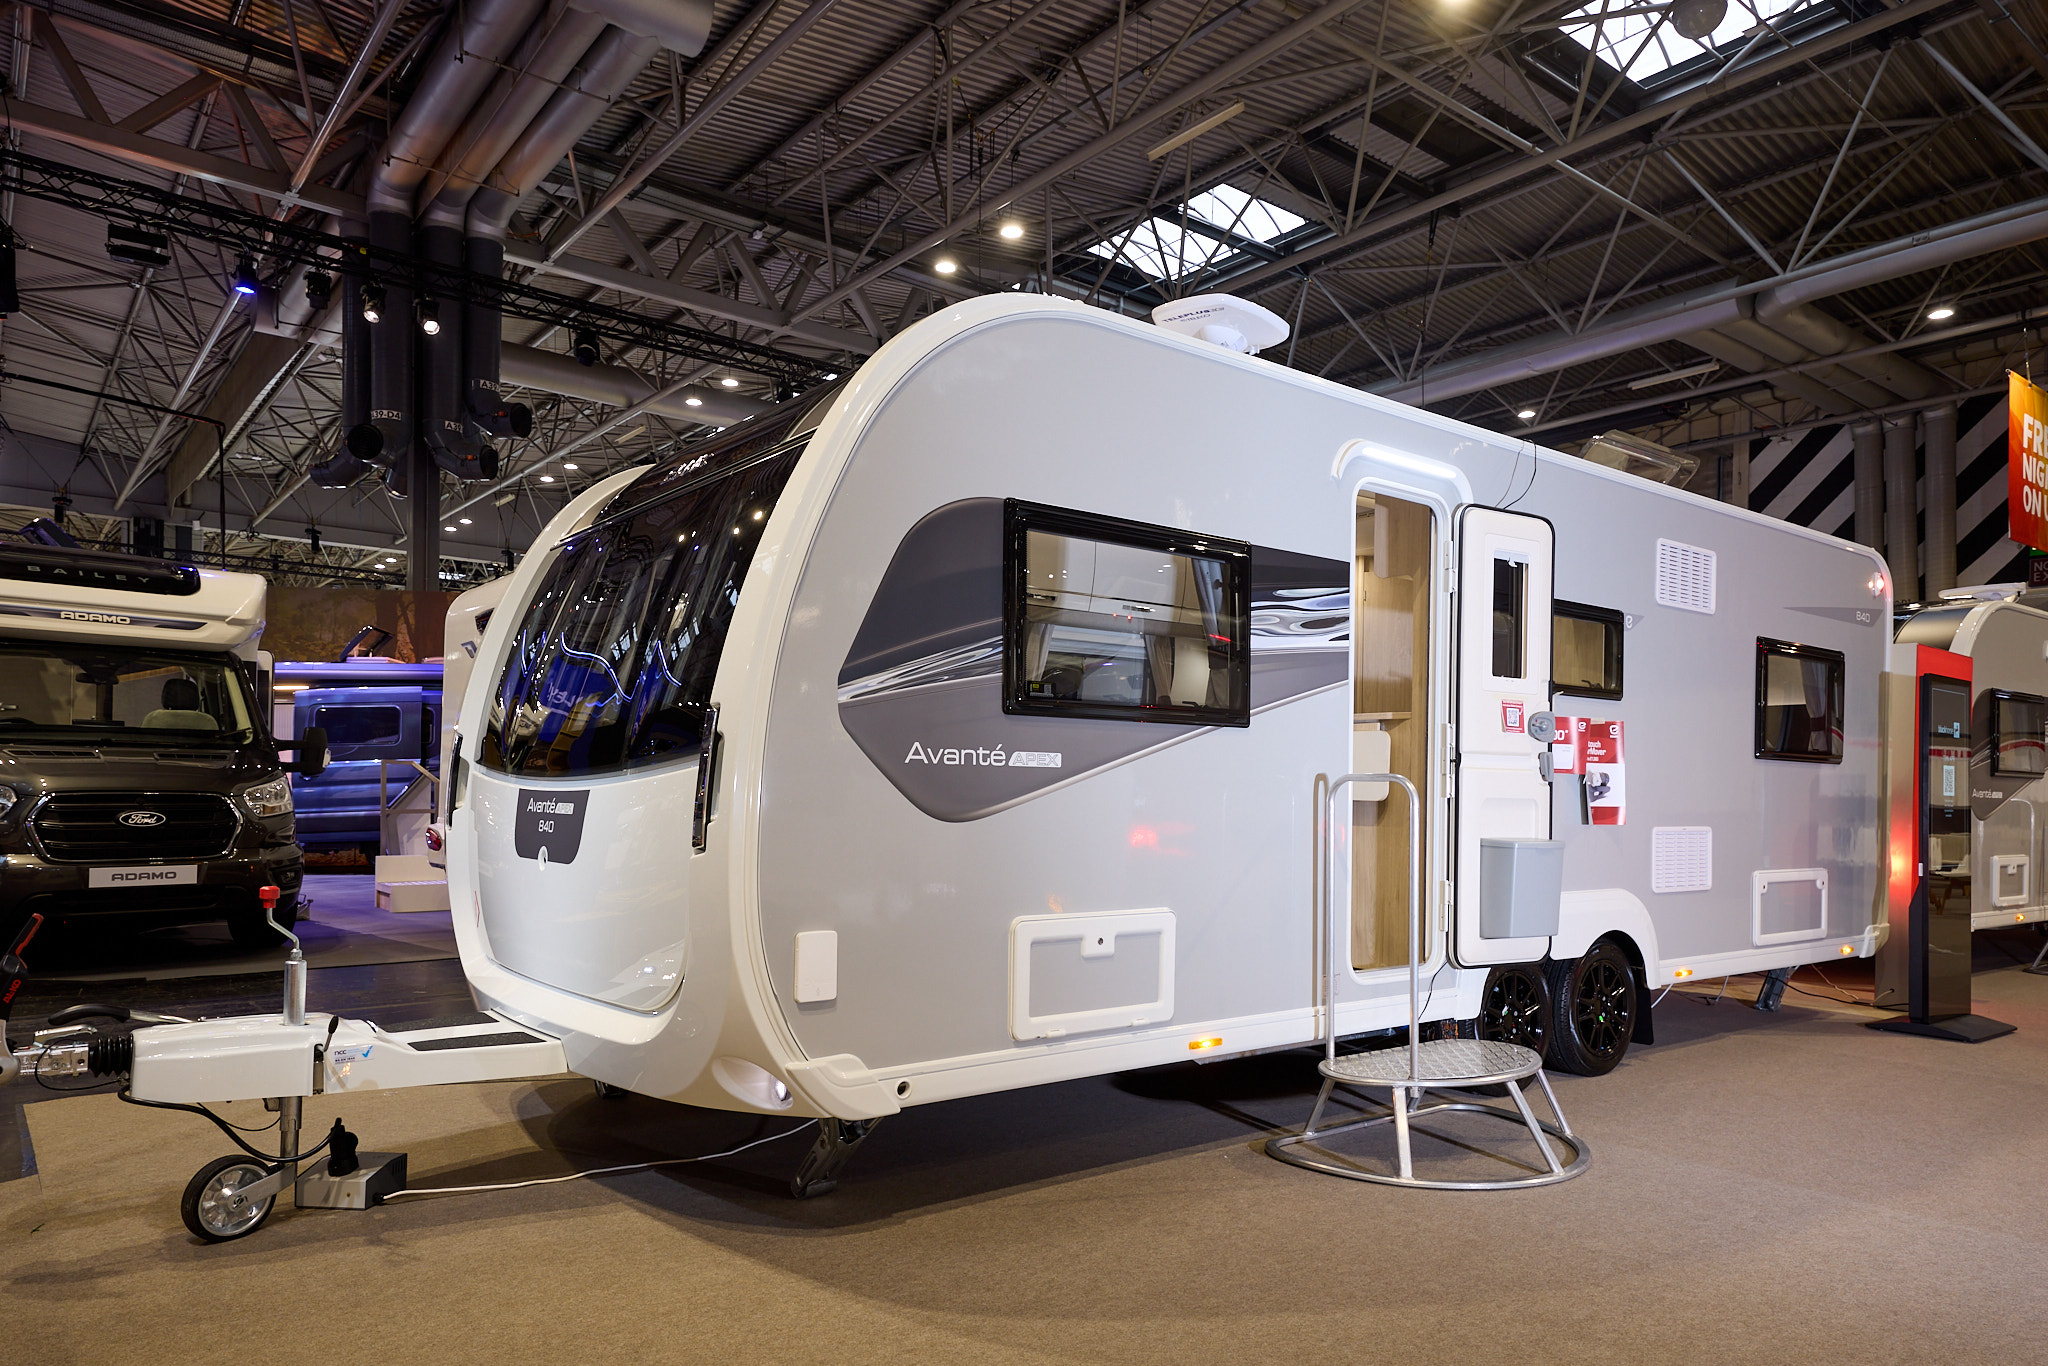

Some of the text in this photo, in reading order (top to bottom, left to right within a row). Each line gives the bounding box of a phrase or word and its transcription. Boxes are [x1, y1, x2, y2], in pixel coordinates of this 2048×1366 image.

[1162, 309, 1210, 322] TELEPLUS
[2022, 485, 2042, 517] ON
[27, 565, 149, 583] BAILEY
[60, 611, 131, 625] ADAMO
[1856, 611, 1871, 623] 840
[903, 741, 1060, 767] Avanté APEX
[526, 797, 556, 814] Avanté
[128, 813, 158, 824] Ford
[538, 820, 555, 833] 840
[111, 871, 177, 882] ADAMO
